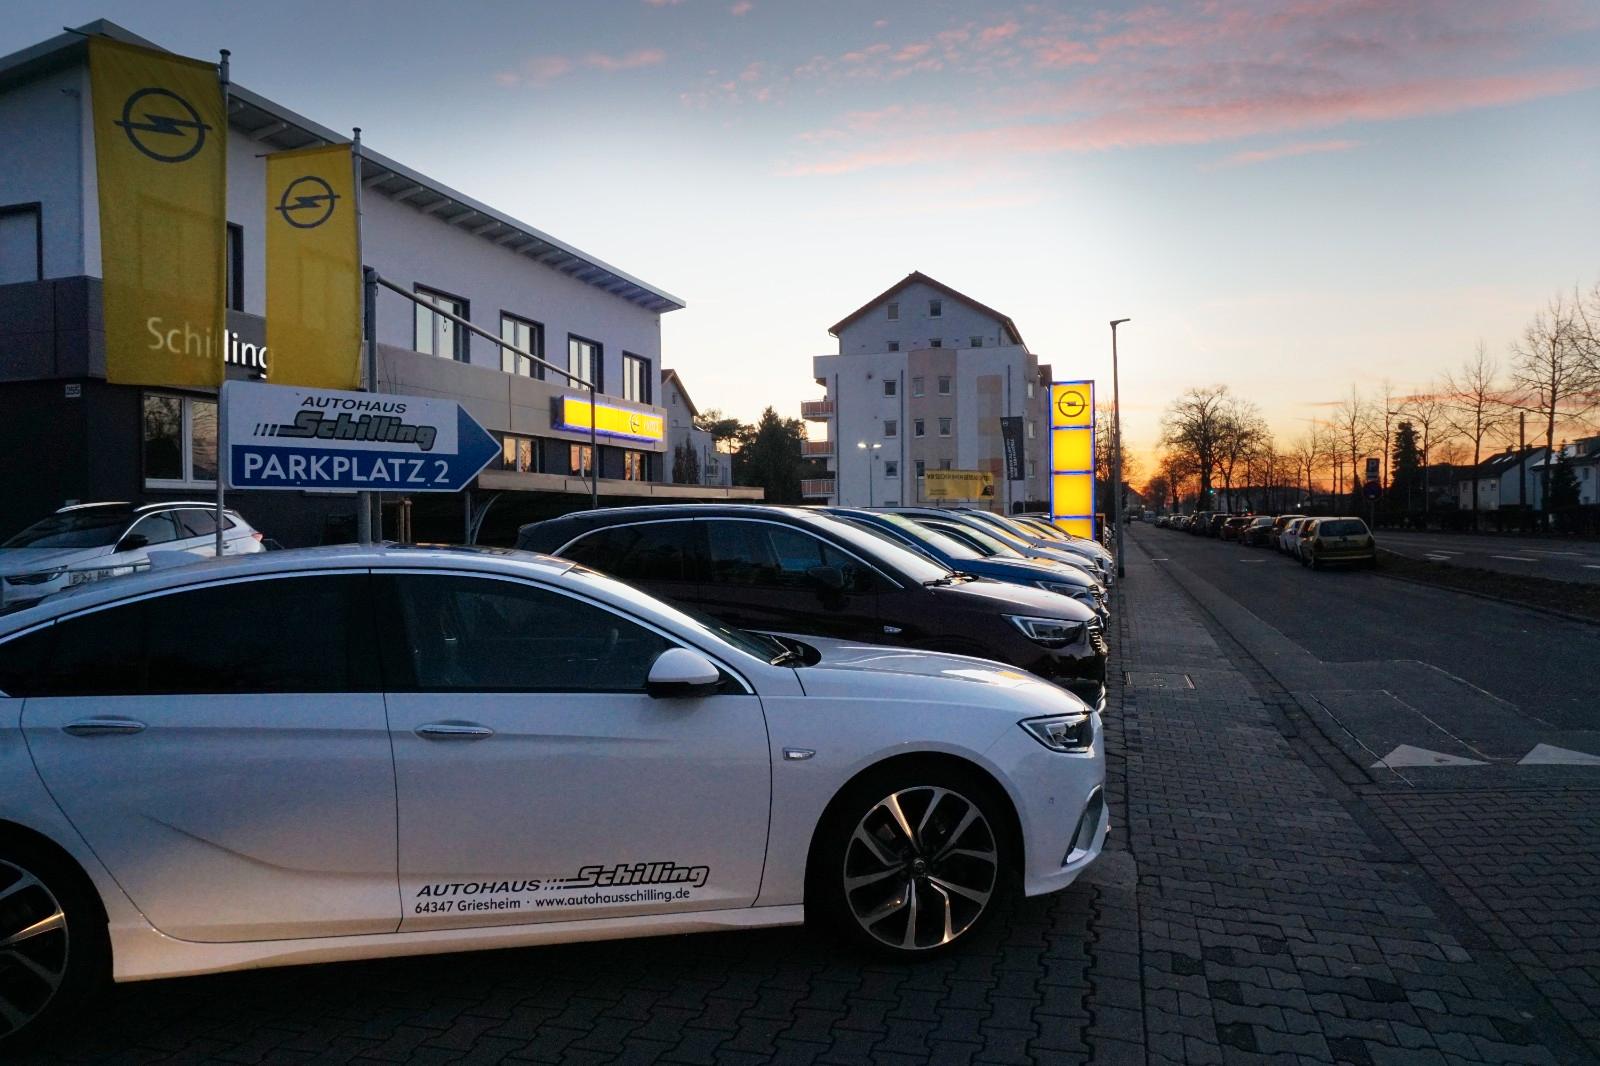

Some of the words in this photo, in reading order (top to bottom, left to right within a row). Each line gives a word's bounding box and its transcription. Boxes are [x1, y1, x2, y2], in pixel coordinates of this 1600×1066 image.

[302, 396, 407, 413] AUTOHAUS
[294, 411, 437, 451] Schilling
[244, 453, 425, 483] PARKPLATZ
[434, 460, 450, 483] 2
[417, 879, 541, 897] AUTOHAUS
[577, 862, 709, 887] Schilling
[415, 901, 454, 914] 64347
[457, 898, 521, 912] Griesheim
[535, 889, 690, 907] www.autohausschilling.de
